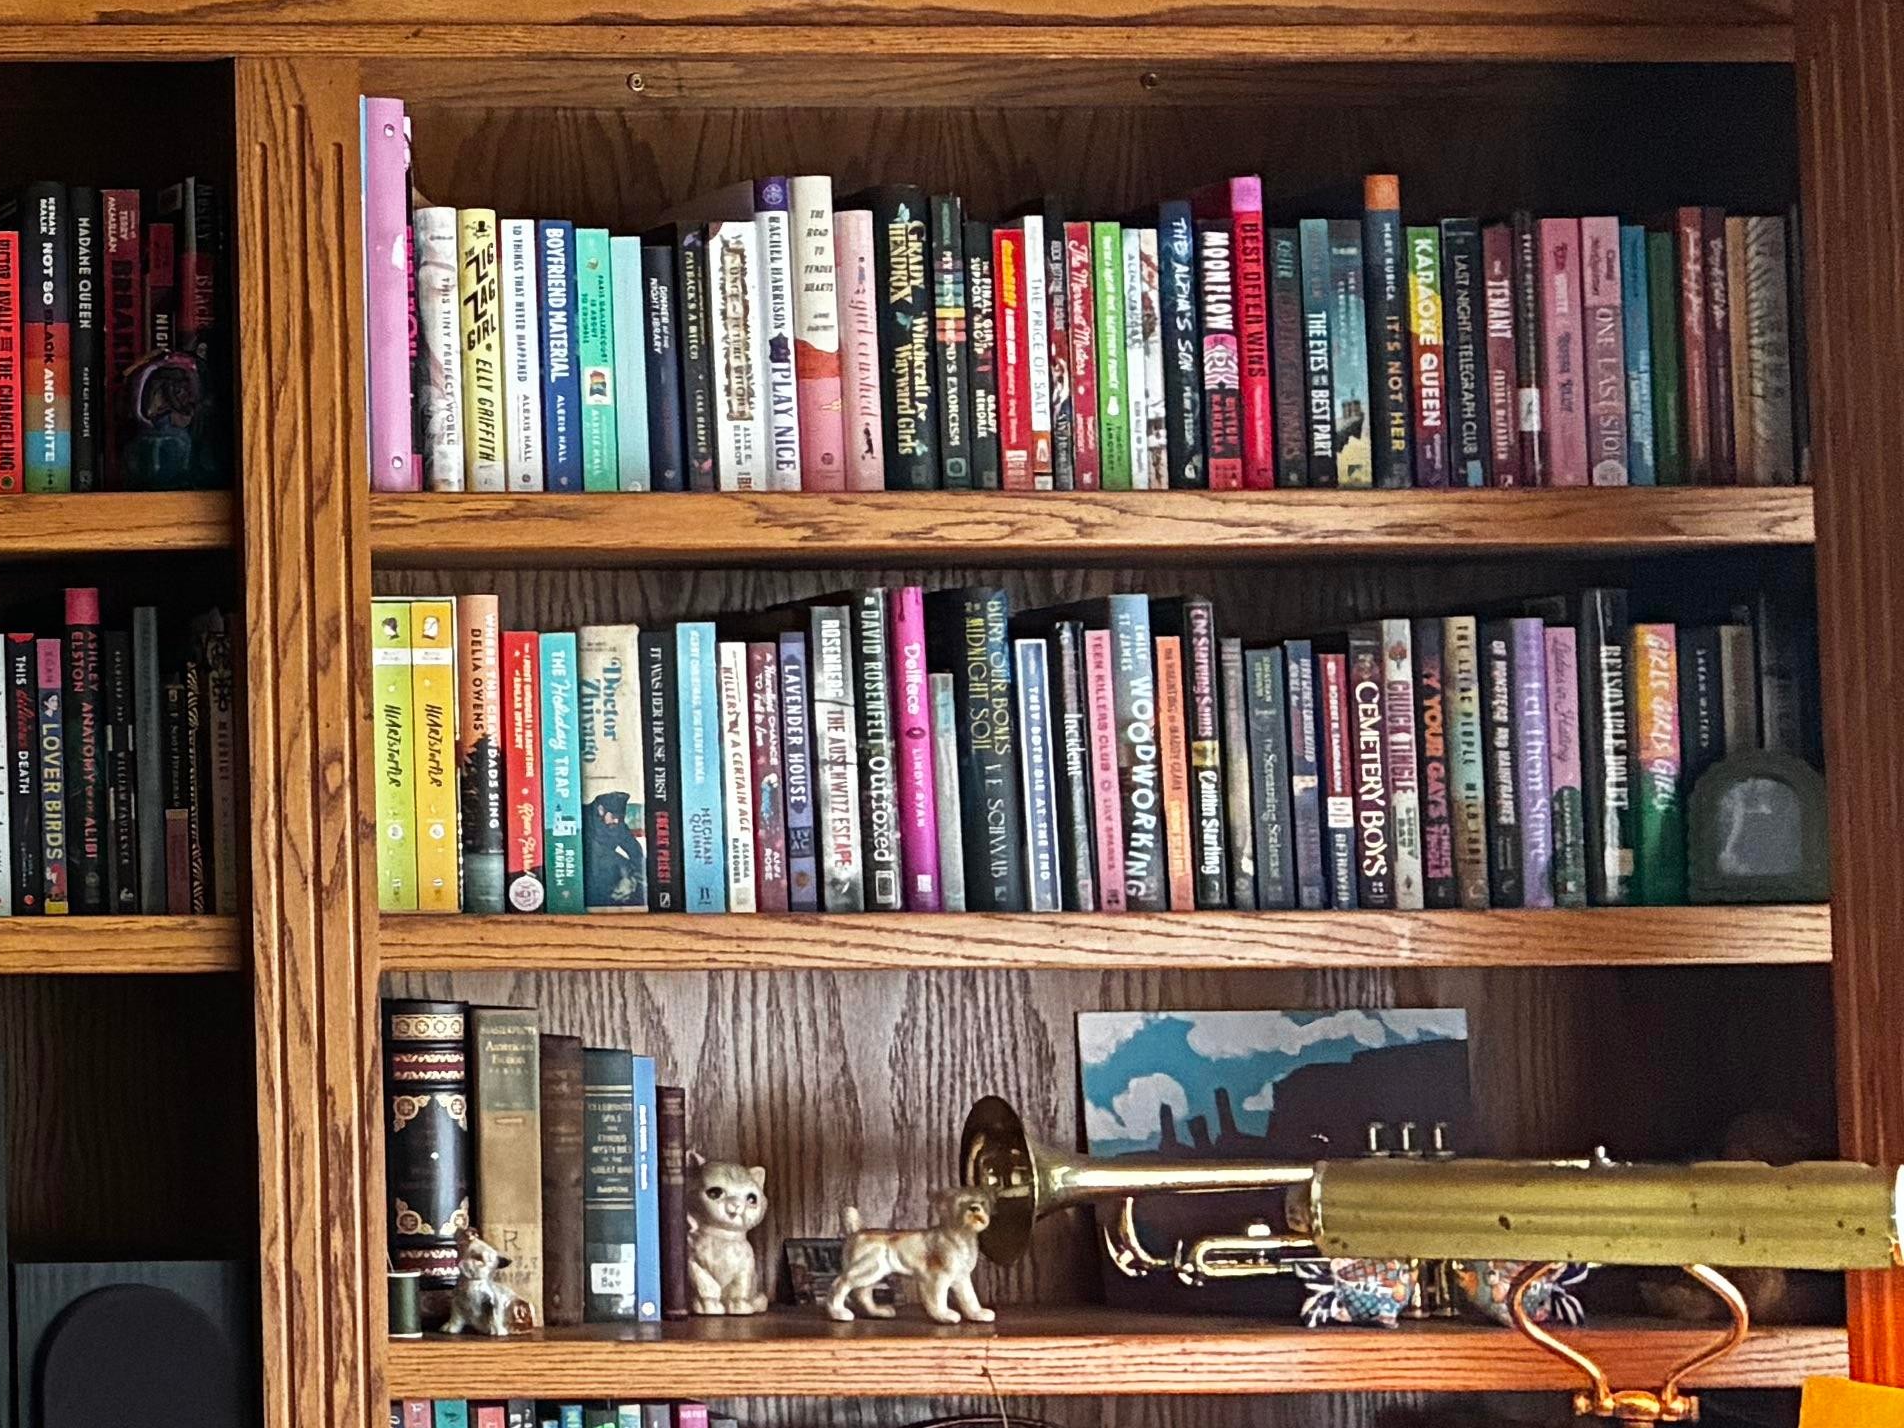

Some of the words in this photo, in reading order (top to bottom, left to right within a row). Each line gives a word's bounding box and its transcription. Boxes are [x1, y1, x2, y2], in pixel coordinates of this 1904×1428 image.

[545, 228, 567, 308] BOYFRIEND
[1031, 278, 1044, 305] THE
[1203, 231, 1233, 329] MOONFLOW
[1414, 238, 1439, 345] KARAOKE
[548, 311, 570, 382] MATERIAL
[1032, 310, 1045, 351] PRICE
[1386, 315, 1400, 351] IT'S
[1034, 356, 1046, 377] OF
[1387, 361, 1402, 402] NOT
[1421, 353, 1441, 426] QUEEN
[772, 371, 792, 417] PLAY
[1035, 382, 1047, 416] SALT
[774, 425, 796, 471] NICE
[1390, 412, 1405, 451] HER
[471, 628, 483, 672] DELIA
[861, 610, 879, 655] DAVID
[552, 651, 566, 676] THE
[473, 678, 484, 730] OWENS
[549, 680, 571, 751] Holiday
[783, 664, 803, 745] LAVENDER
[864, 662, 885, 744] ROSENFELT
[42, 724, 61, 793] LOVER
[1355, 681, 1384, 802] CEMETERY
[555, 756, 570, 798] TRAP
[789, 753, 806, 803] HOUSE
[1124, 675, 1157, 897] WOODWORKING
[46, 800, 63, 860] BIRDS
[868, 757, 895, 861] Outfoxed
[1360, 811, 1387, 876] BOYS
